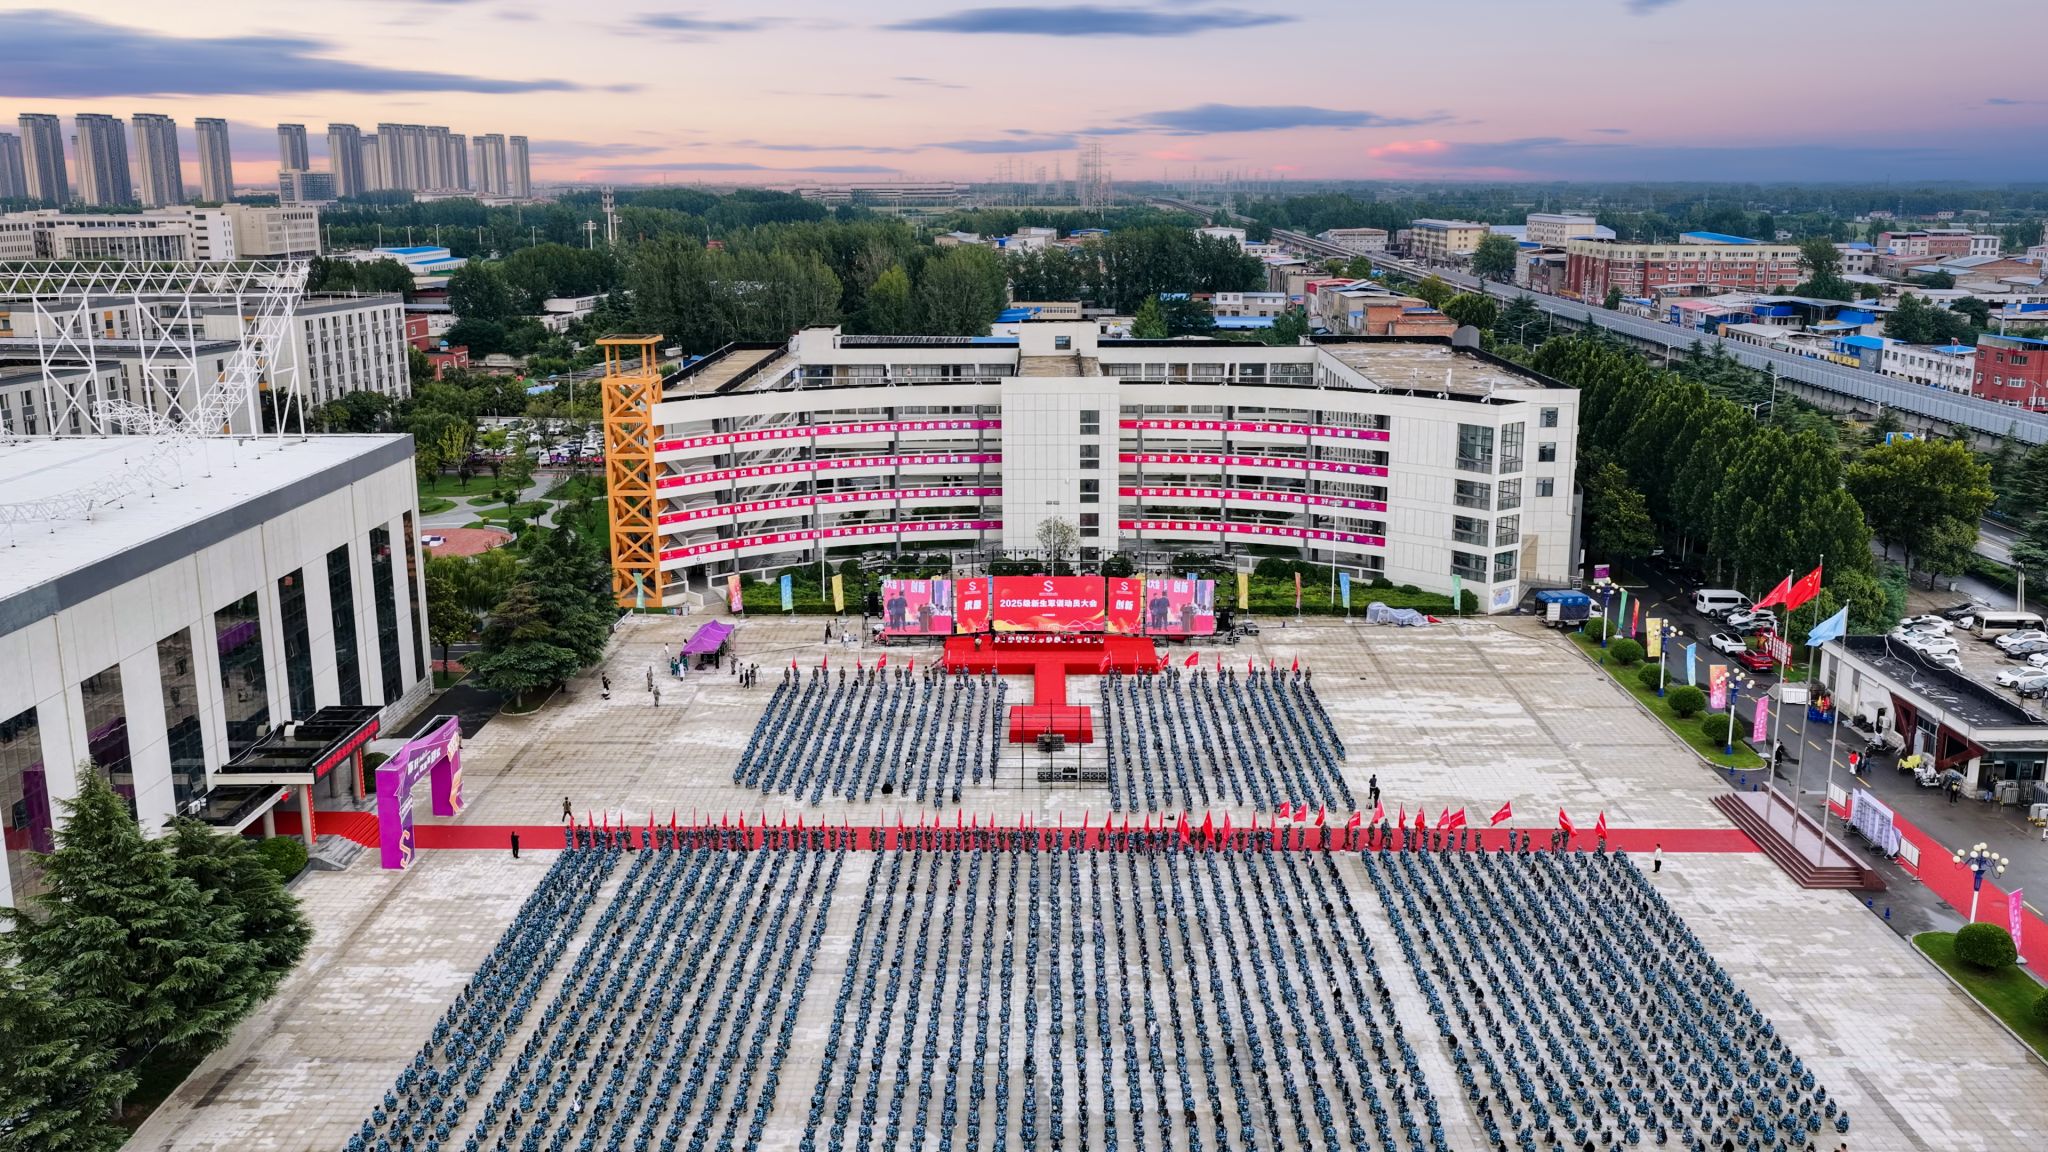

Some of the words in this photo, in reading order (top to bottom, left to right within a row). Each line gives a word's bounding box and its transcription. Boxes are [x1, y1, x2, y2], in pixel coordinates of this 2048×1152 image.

[1252, 493, 1356, 508] 科技开启美好来
[1000, 599, 1097, 608] 2025级新生军训动员大会
[1115, 599, 1134, 611] 创新
